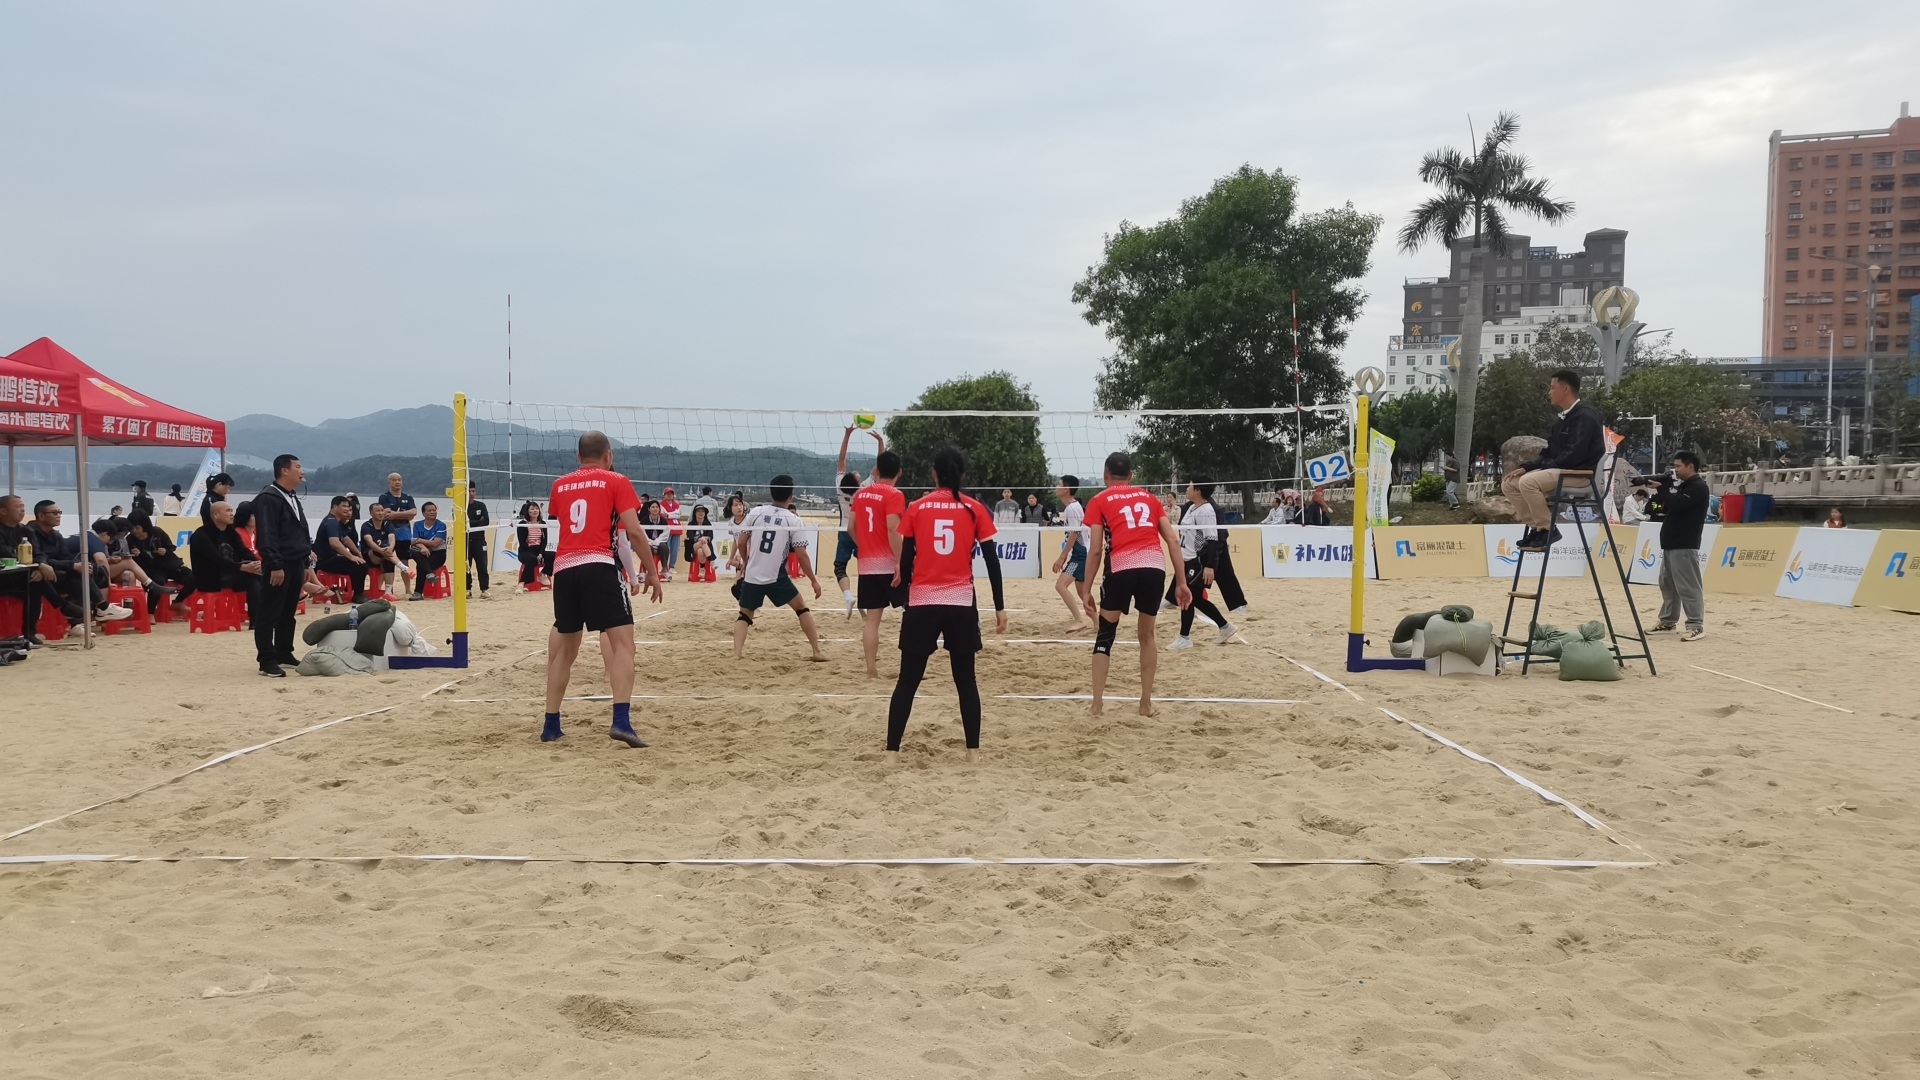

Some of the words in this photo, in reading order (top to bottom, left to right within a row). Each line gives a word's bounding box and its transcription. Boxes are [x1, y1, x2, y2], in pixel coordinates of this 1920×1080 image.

[102, 415, 152, 437] 累了困了
[155, 421, 213, 444] 喝东鹏特饮
[1309, 455, 1348, 483] 02
[570, 499, 587, 534] 9
[1119, 502, 1153, 529] 12
[759, 529, 776, 554] 8
[933, 519, 955, 555] 5
[1416, 541, 1466, 551] 富丽混凝土
[1737, 549, 1777, 562] 富丽混凝土
